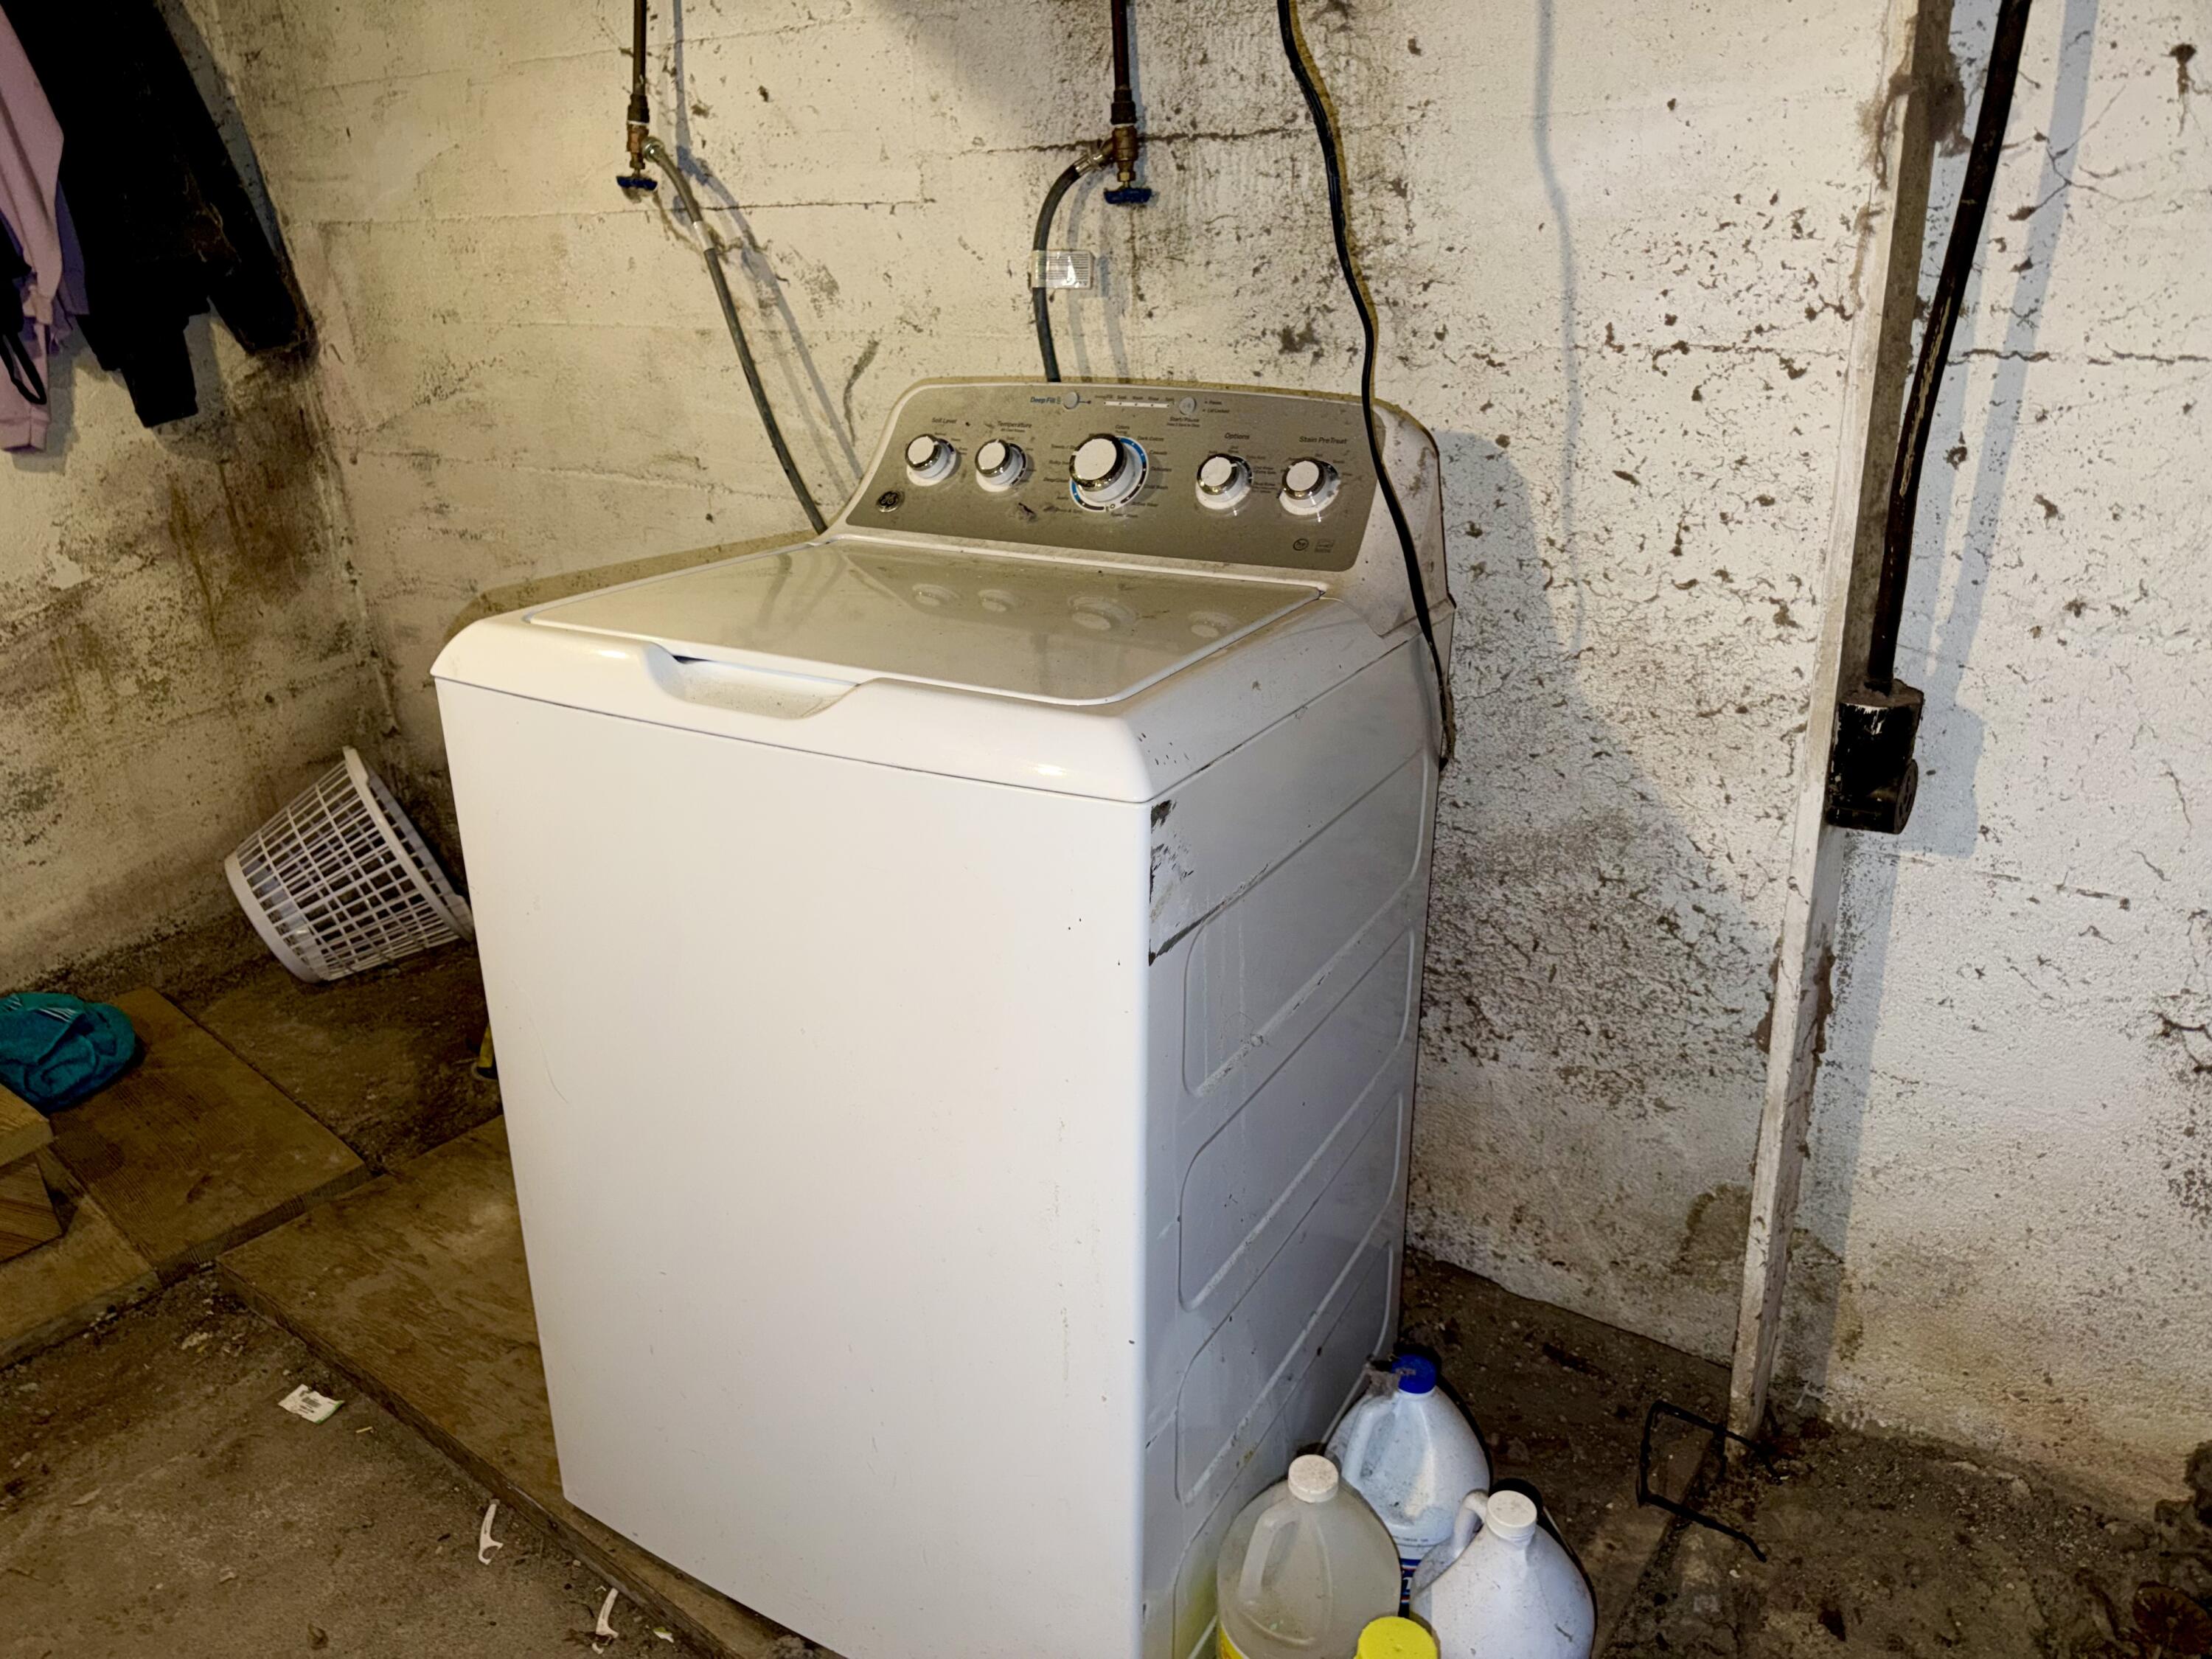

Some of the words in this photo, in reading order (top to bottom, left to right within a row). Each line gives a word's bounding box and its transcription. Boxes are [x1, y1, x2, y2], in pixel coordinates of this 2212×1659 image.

[1030, 396, 1045, 405] Deep
[997, 420, 1032, 428] Temperature
[1224, 432, 1251, 440] Options
